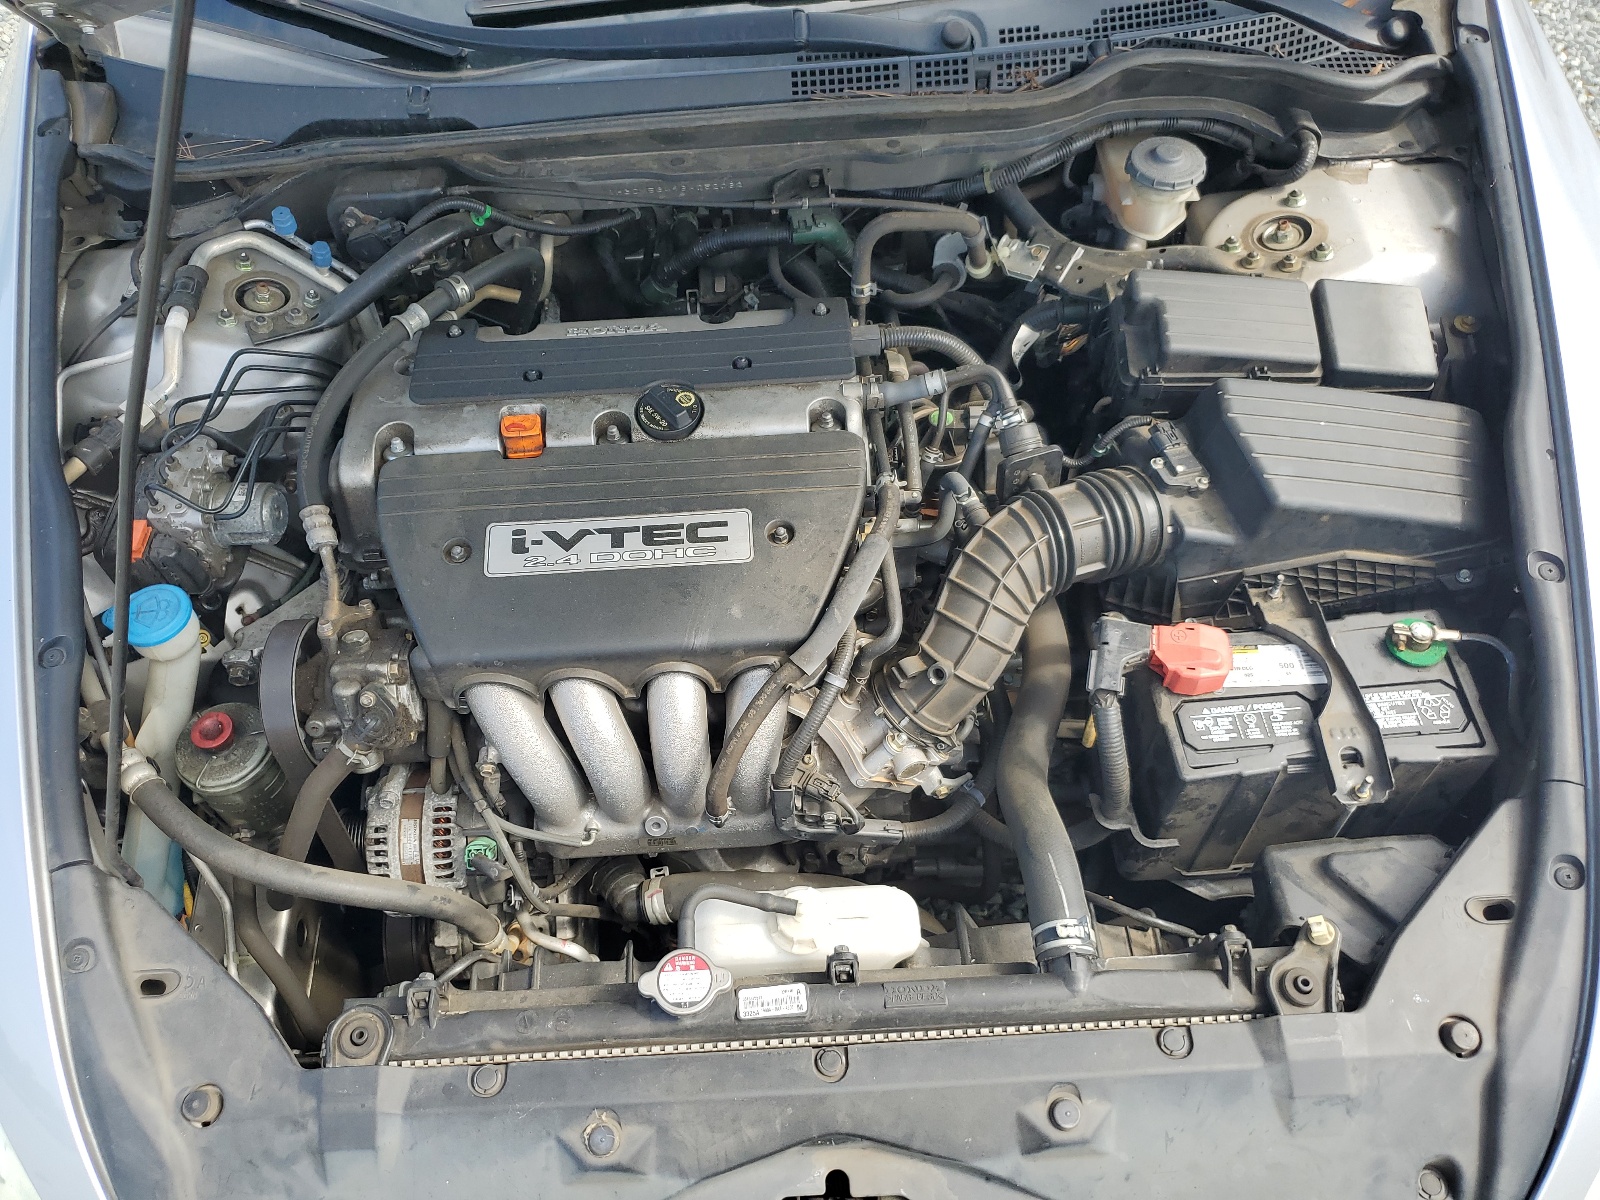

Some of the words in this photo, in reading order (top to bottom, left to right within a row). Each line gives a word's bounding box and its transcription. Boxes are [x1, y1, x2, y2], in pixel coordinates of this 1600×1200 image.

[566, 322, 668, 337] HONDA
[511, 520, 729, 554] i-VTEC
[523, 553, 582, 568] 2.4
[589, 545, 717, 565] DOHC
[1210, 705, 1246, 713] DANGER
[1253, 702, 1285, 711] POISON
